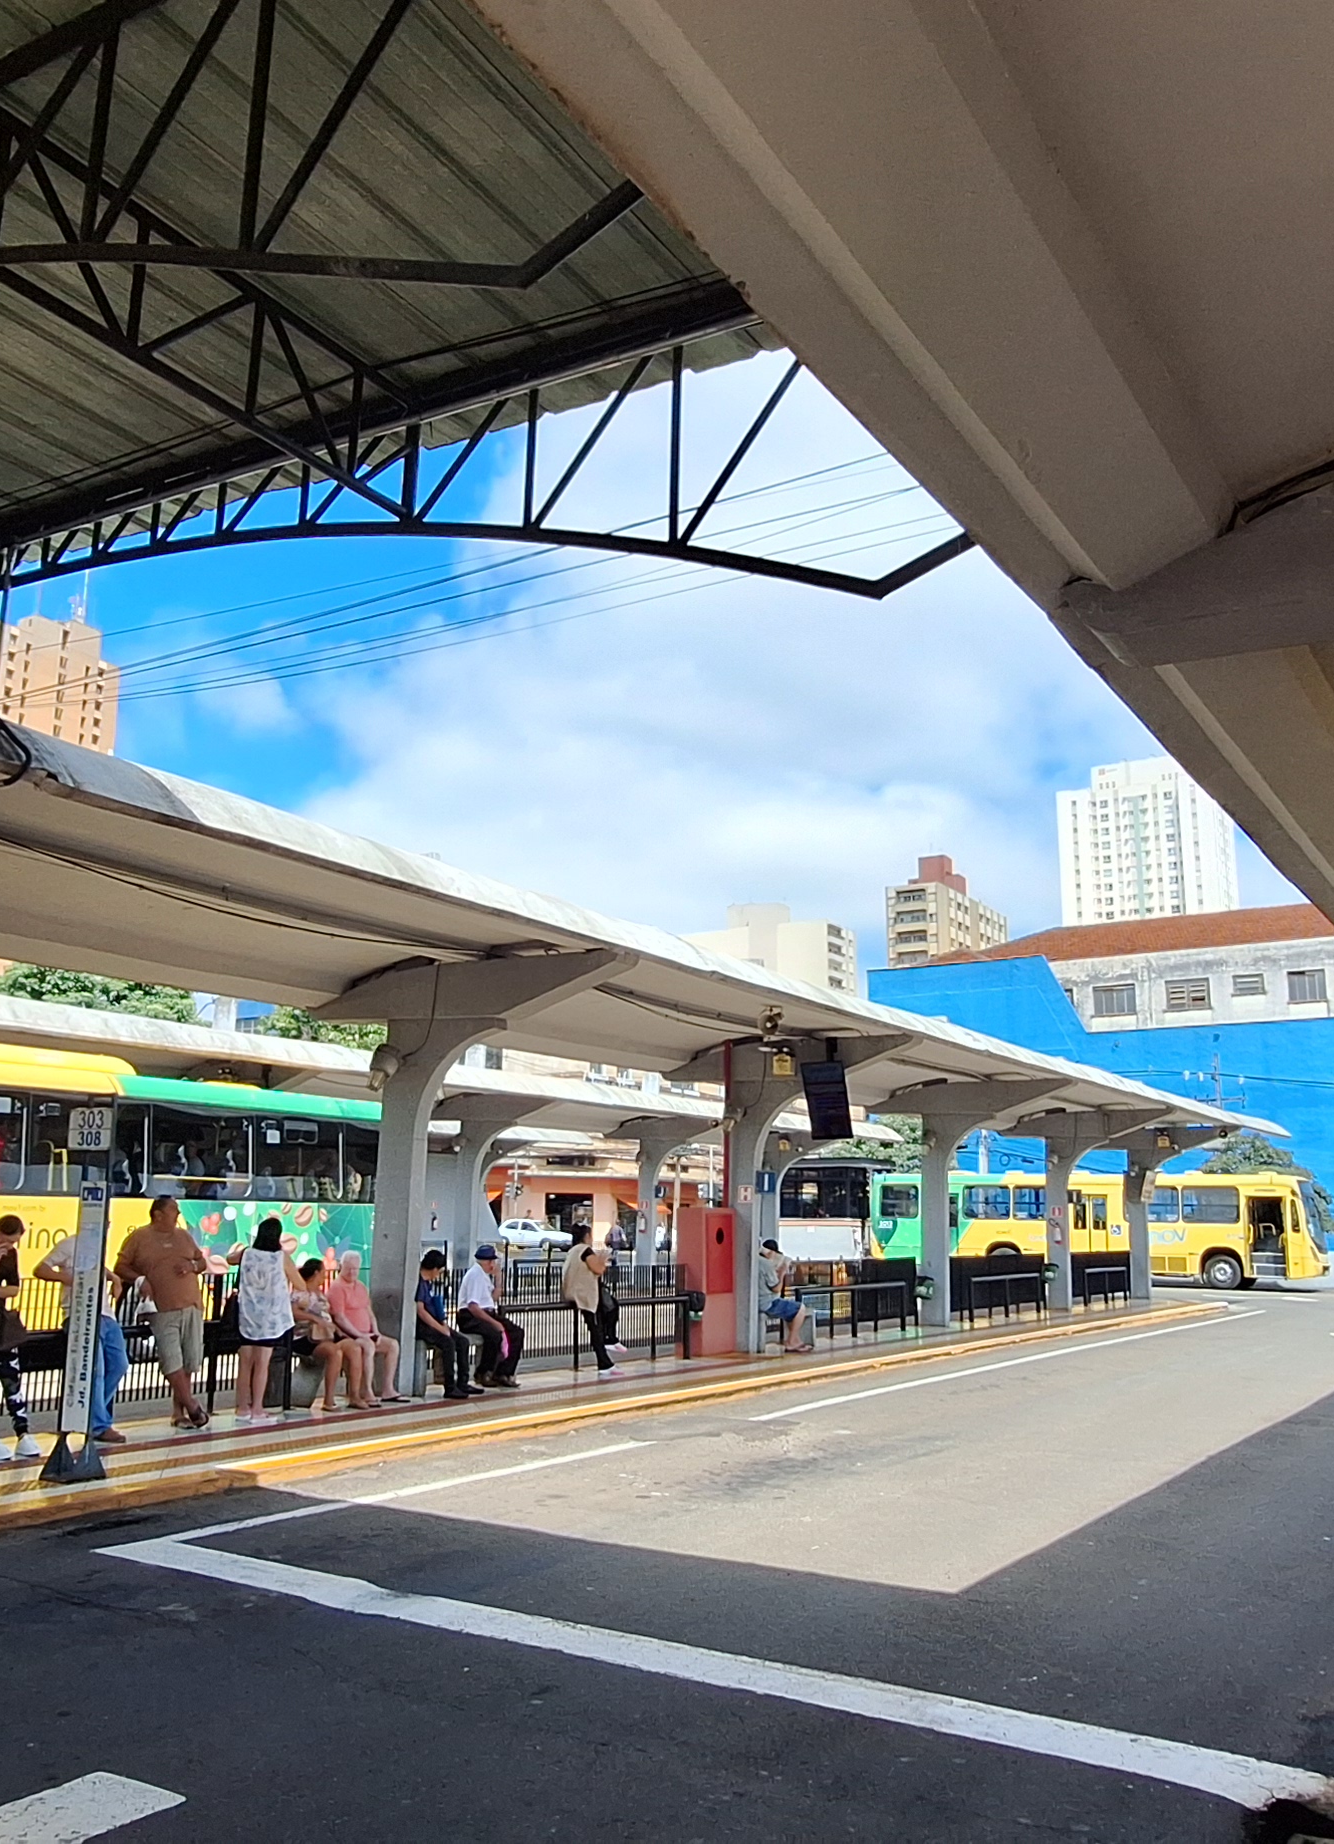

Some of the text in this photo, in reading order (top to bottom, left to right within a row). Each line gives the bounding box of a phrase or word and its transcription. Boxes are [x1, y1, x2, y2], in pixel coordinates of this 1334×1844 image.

[77, 1109, 104, 1129] 303
[77, 1130, 102, 1147] 308
[78, 1287, 94, 1409] Jd. Bandeirantes
